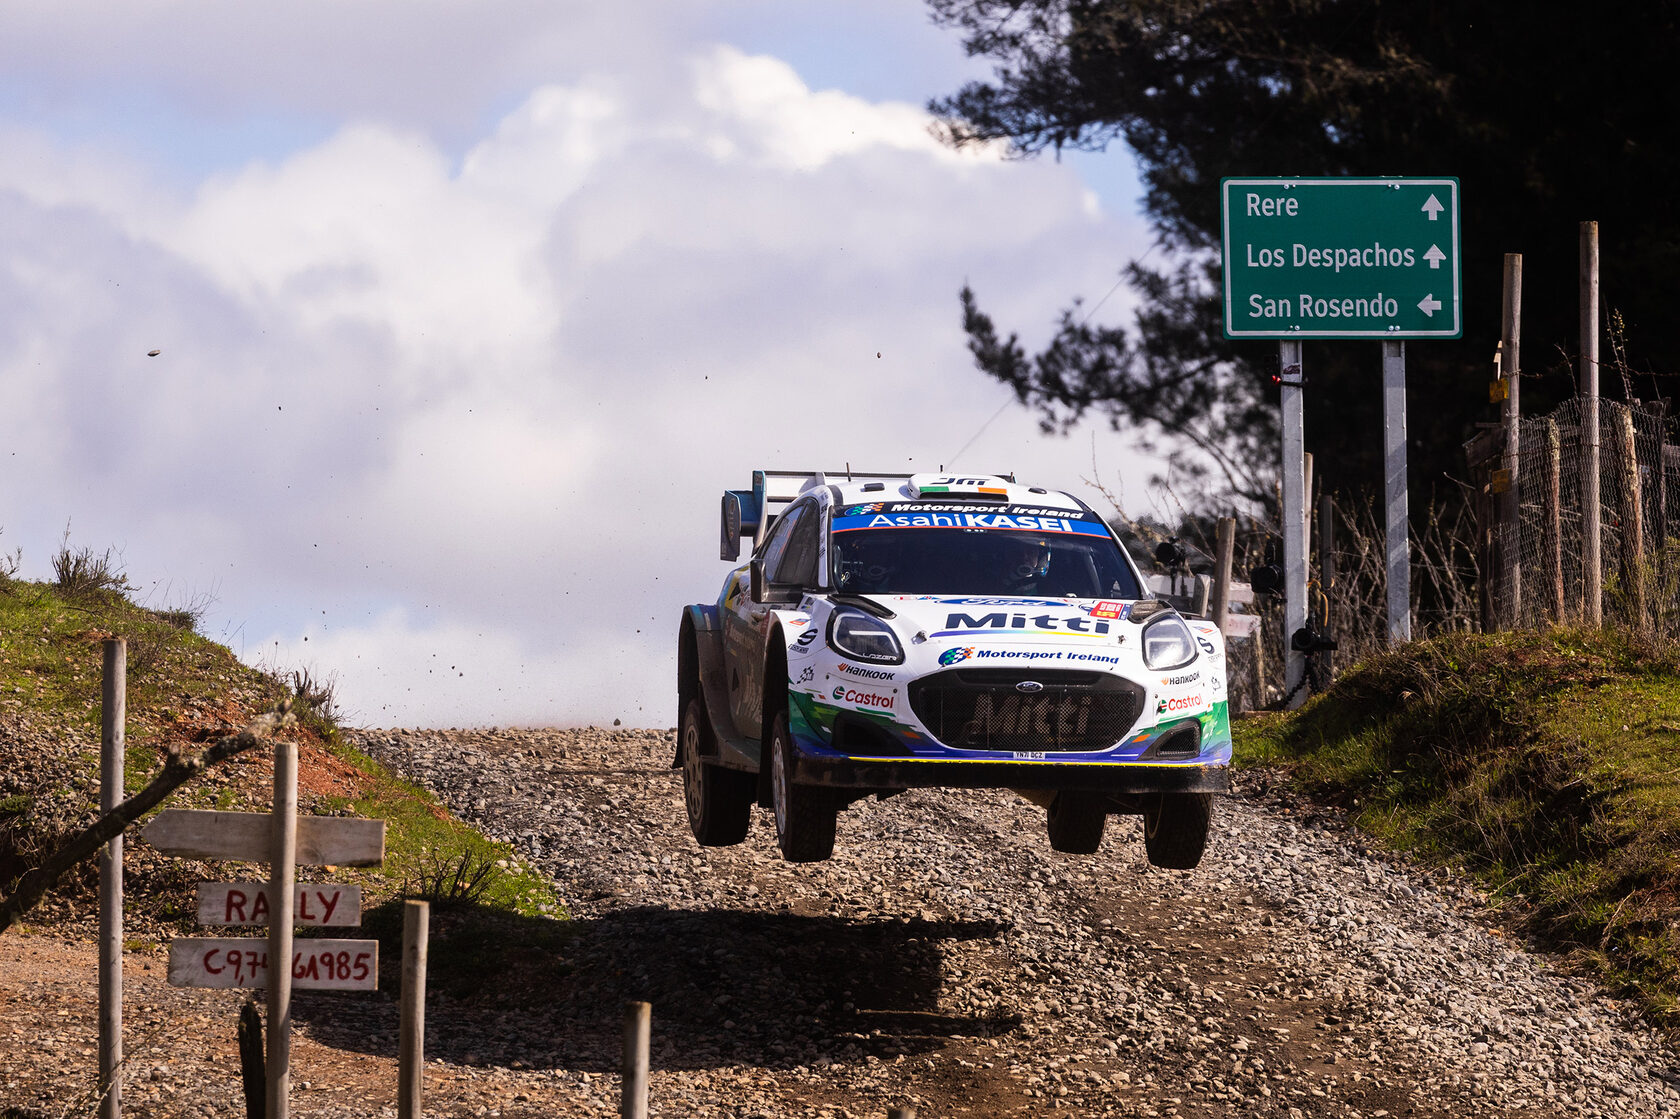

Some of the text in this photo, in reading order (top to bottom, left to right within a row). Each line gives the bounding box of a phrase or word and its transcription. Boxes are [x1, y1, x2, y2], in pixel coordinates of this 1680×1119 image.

[1247, 193, 1298, 216] Rere
[1247, 242, 1415, 272] Los Despachos
[1248, 293, 1398, 318] San Rosendo
[890, 503, 1084, 519] Motorsport Ireland
[868, 513, 1074, 532] AsahiKASEI
[945, 612, 1110, 634] Mitti
[977, 650, 1119, 664] Motorsport Ireland
[845, 690, 894, 708] Castrol
[1168, 693, 1203, 711] Castrol
[973, 693, 1092, 735] Mitti
[225, 890, 341, 924] RALY
